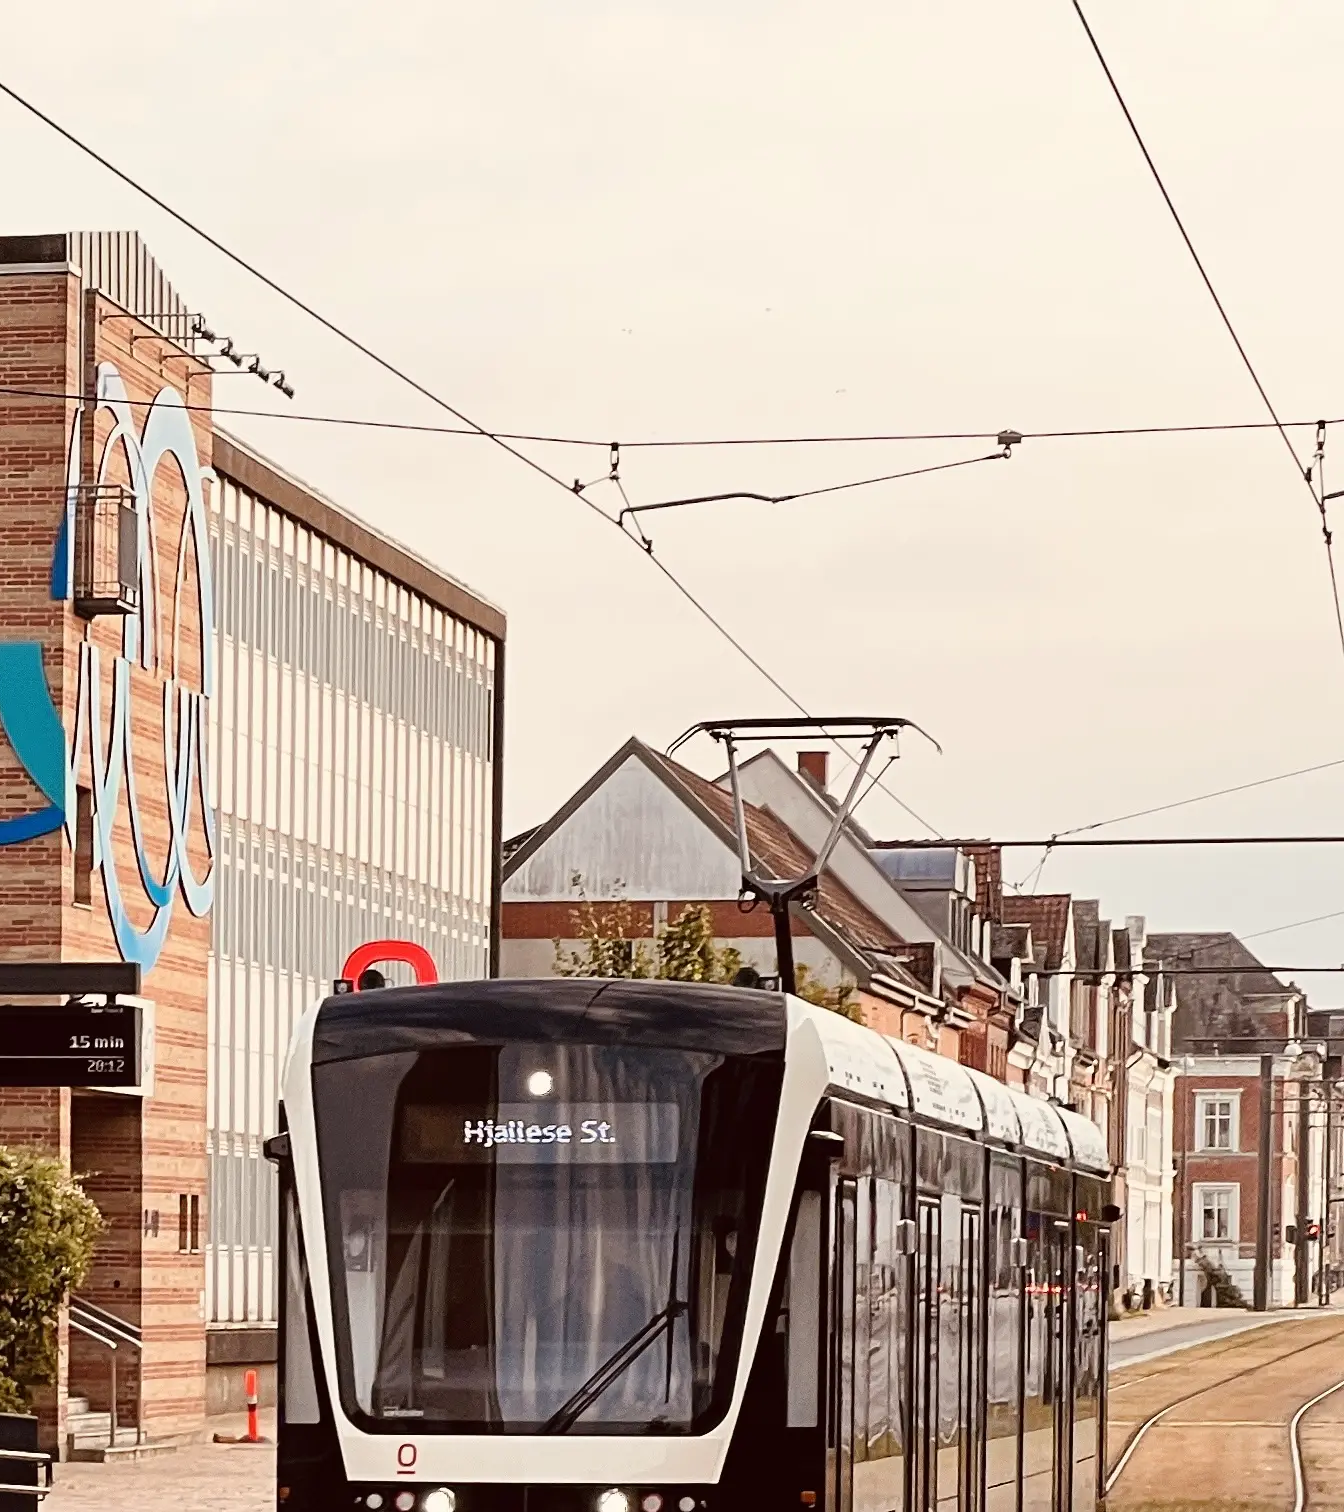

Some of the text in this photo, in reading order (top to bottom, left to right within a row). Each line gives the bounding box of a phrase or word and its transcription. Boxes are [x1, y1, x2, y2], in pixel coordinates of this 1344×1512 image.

[69, 1035, 90, 1049] 15
[94, 1035, 124, 1049] min
[87, 1059, 125, 1073] 20:12
[464, 1119, 616, 1148] Hjallese St.
